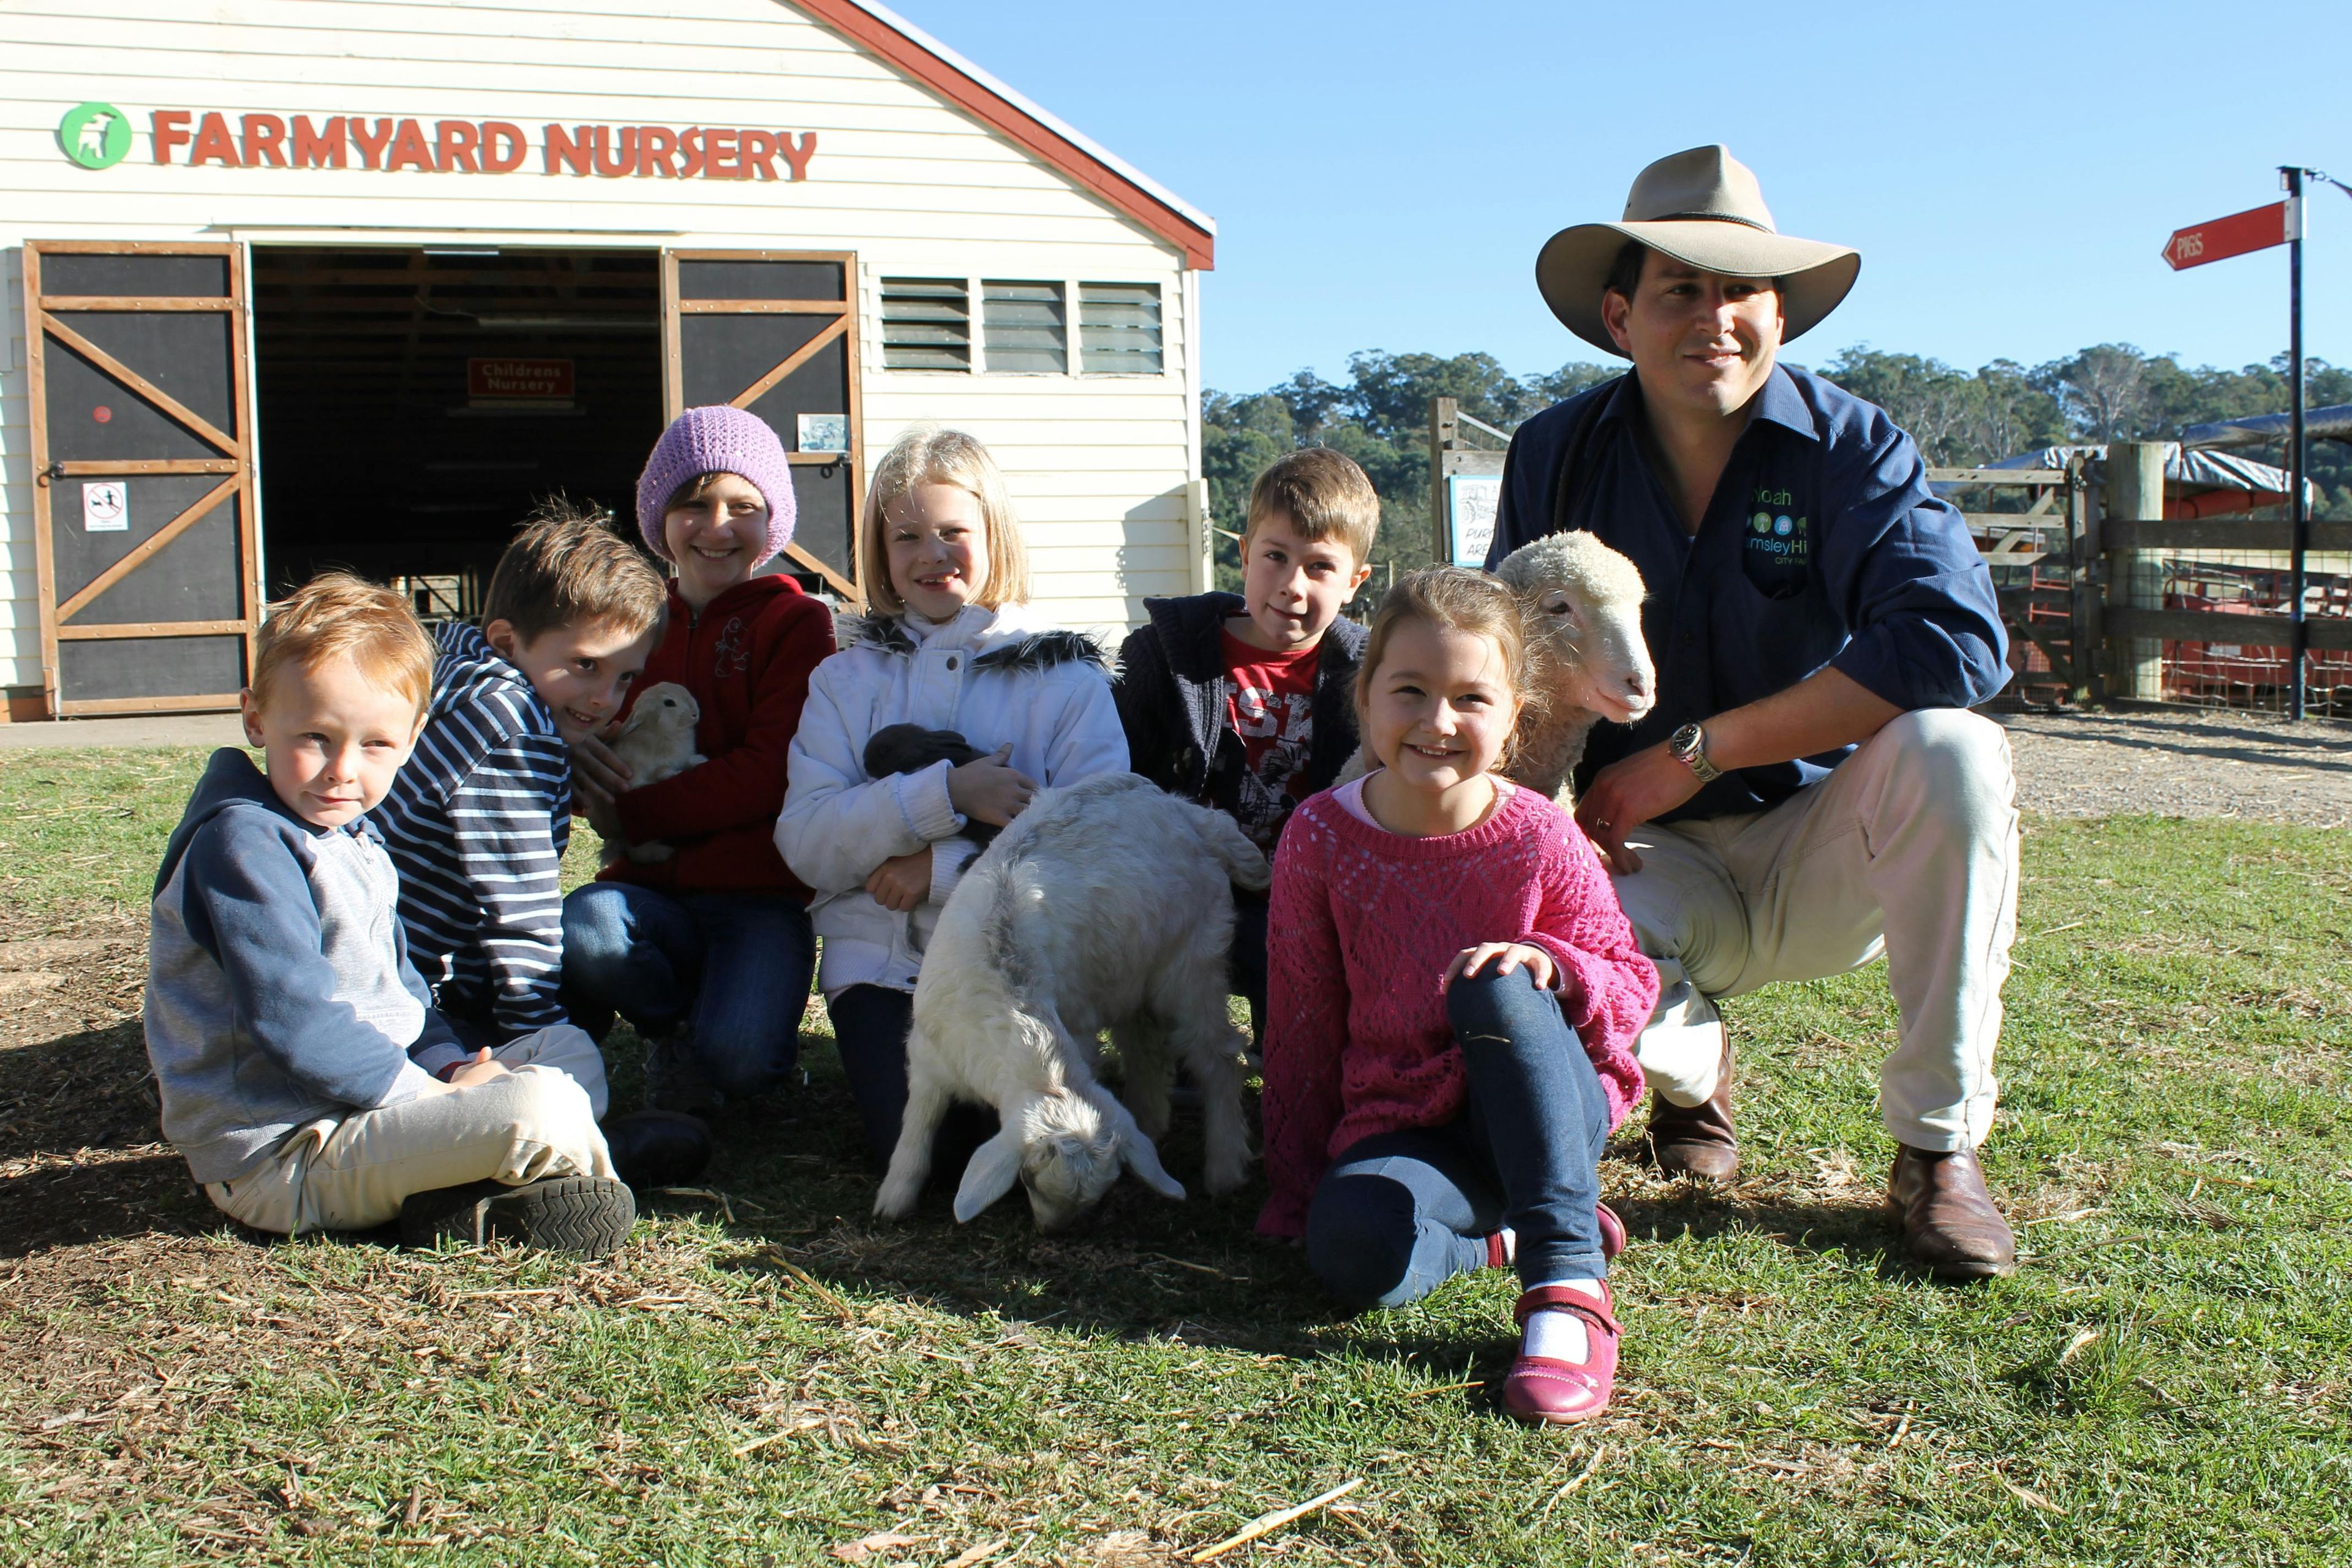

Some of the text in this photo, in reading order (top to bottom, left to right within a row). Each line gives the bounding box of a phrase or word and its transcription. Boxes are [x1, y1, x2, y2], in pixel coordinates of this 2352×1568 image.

[152, 110, 817, 181] FARMYARD NURSERY
[2176, 232, 2203, 260] PIGS
[482, 363, 562, 377] Childrens
[488, 378, 555, 393] Nursery
